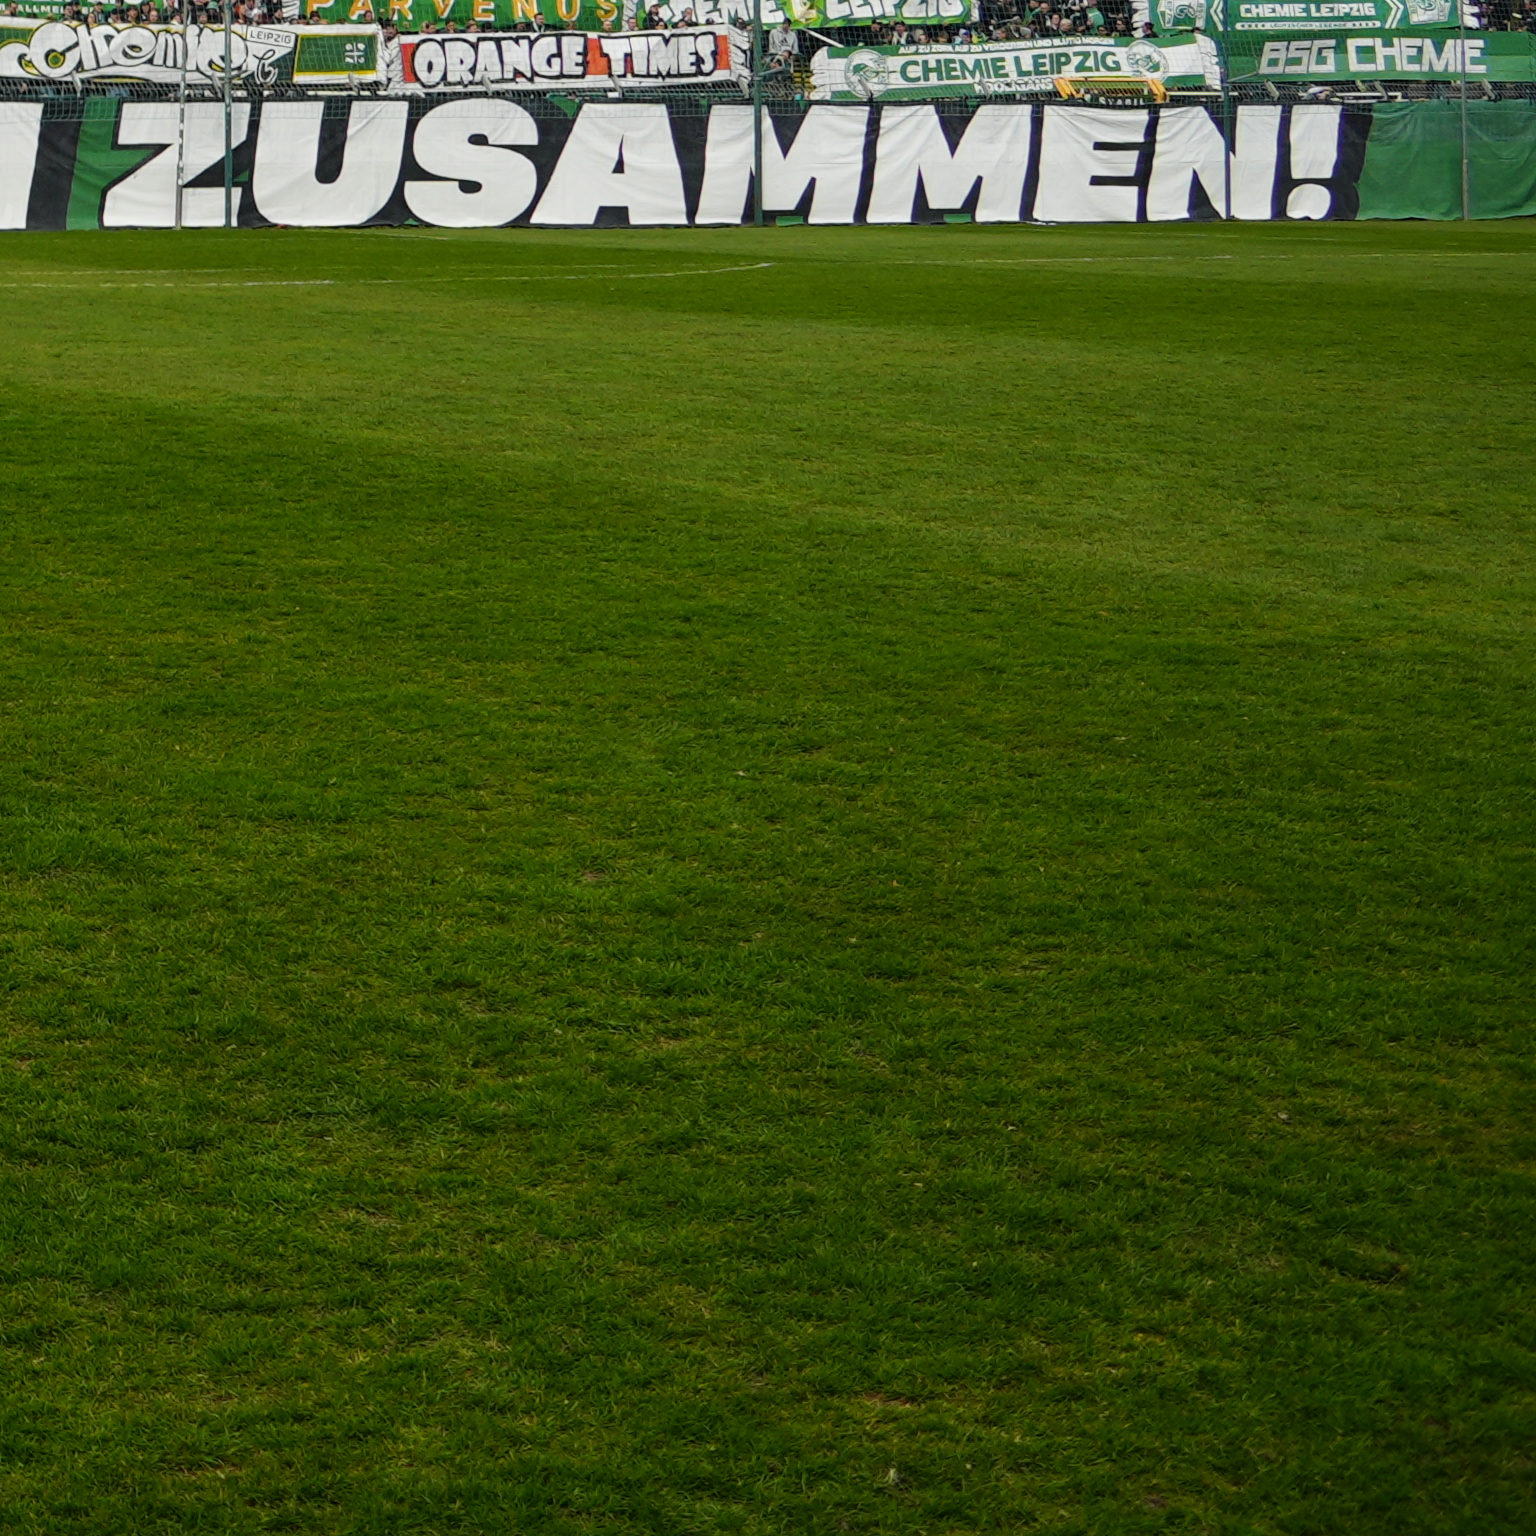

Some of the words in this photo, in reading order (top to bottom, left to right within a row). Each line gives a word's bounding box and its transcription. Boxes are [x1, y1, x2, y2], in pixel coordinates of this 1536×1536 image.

[1239, 3, 1308, 18] CHEMIE
[1309, 2, 1376, 17] LEIPZIG
[249, 29, 293, 45] LEIPZIG
[413, 34, 588, 87] ORANGE
[599, 32, 718, 81] TIMES
[899, 56, 1009, 83] CHEMIE
[1014, 50, 1122, 77] LEIPZIG
[1259, 39, 1336, 74] BSG
[1347, 37, 1488, 73] CHEMIE
[974, 78, 1054, 95] HOOLIGANS
[100, 98, 1341, 230] ZUSAMMEN!
